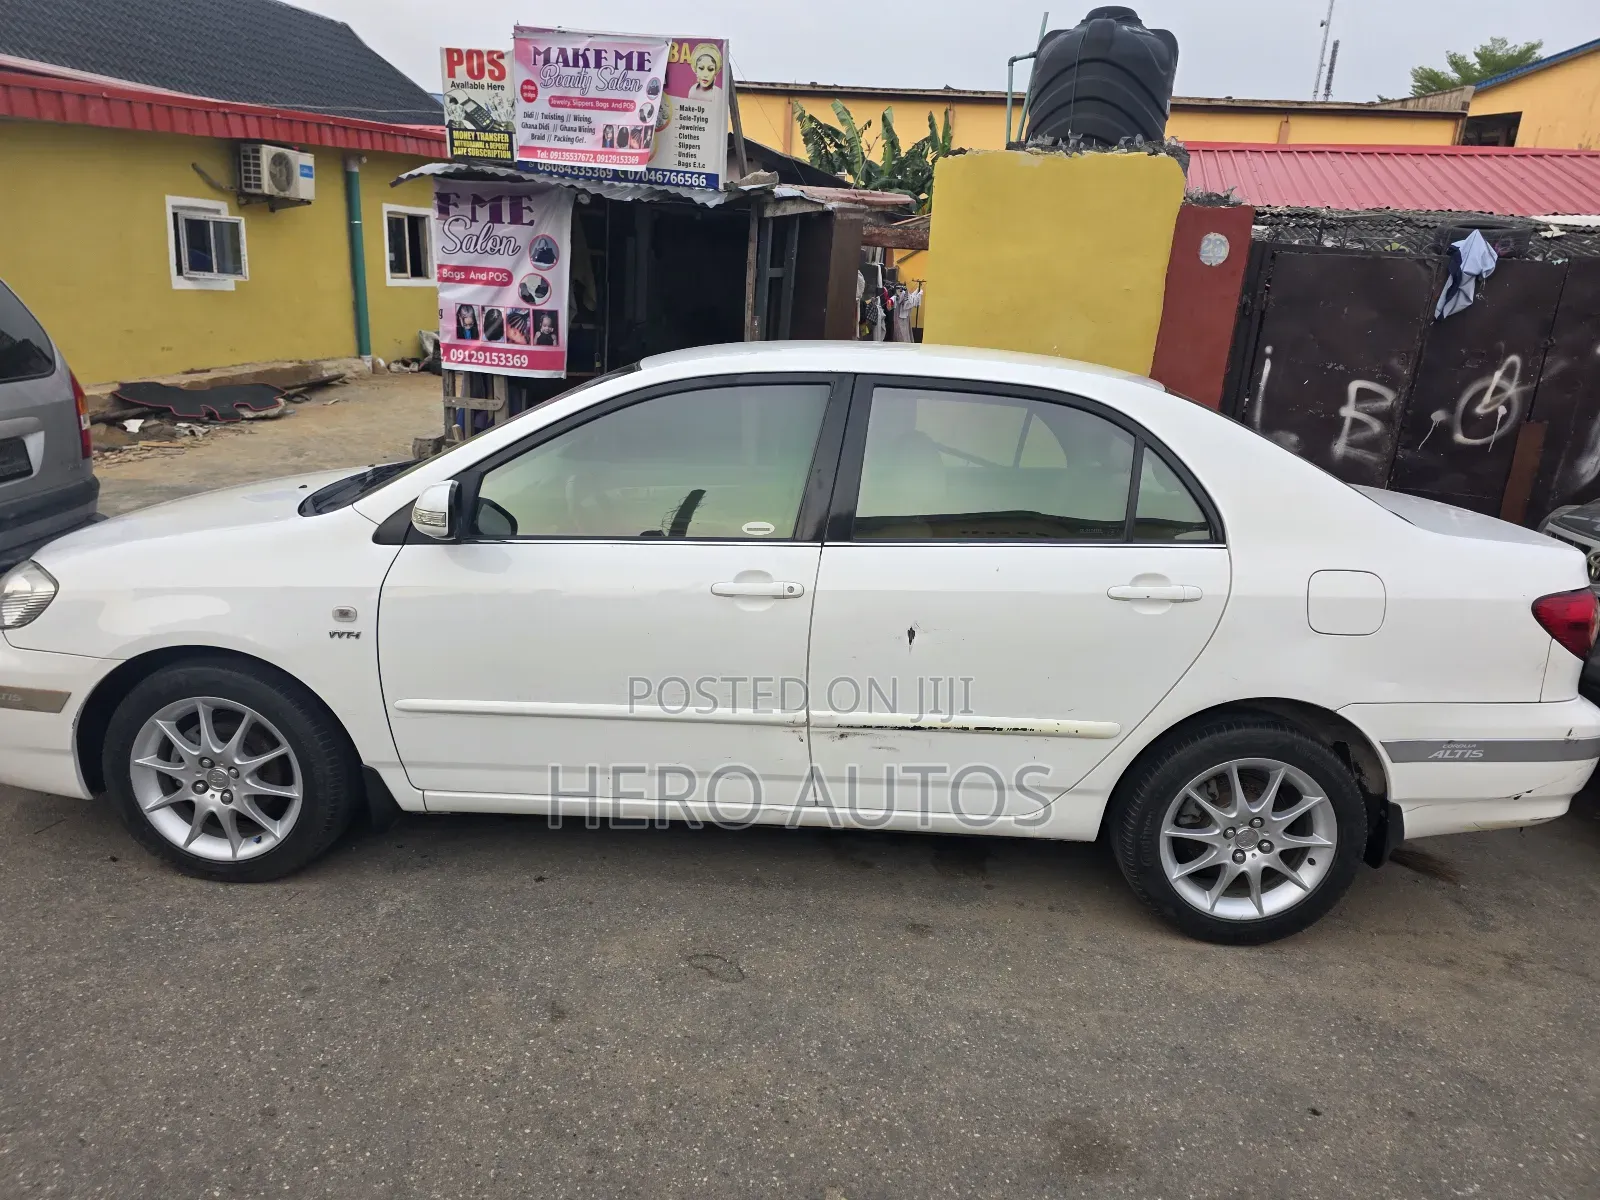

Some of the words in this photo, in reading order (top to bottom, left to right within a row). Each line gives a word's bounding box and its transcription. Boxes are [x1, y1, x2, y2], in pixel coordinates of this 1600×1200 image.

[445, 48, 506, 81] POS
[540, 62, 592, 96] Beauty
[595, 65, 643, 93] Salon
[450, 81, 485, 90] Available
[487, 82, 505, 91] Here
[595, 100, 609, 109] Bags
[611, 100, 622, 109] And
[622, 101, 635, 110] POS
[679, 104, 705, 114] Make-Up
[523, 111, 535, 119] Didi
[540, 112, 565, 122] Twisting
[679, 114, 709, 124] Gele-Tying
[521, 122, 538, 130] Ghana
[538, 122, 550, 131] Didi
[559, 124, 577, 133] Ghana
[452, 130, 475, 140] MONEY
[476, 131, 510, 142] TRANSFER
[530, 133, 546, 141] Braid
[553, 134, 574, 144] Packing
[678, 132, 700, 141] Clothes
[489, 142, 509, 150] DEPOSIT
[678, 142, 701, 151] Slippers
[467, 147, 512, 159] SUBSCRIPTION
[537, 150, 549, 159] Tel:
[596, 154, 639, 165] 09129153369
[677, 151, 697, 159] Undies
[677, 160, 692, 169] Bags
[627, 170, 707, 187] 07046766566
[470, 193, 535, 226] ME
[441, 215, 521, 256] Salon
[442, 268, 465, 280] Bags
[469, 270, 487, 281] And
[488, 271, 508, 282] POS
[450, 348, 528, 367] 09129153369
[1427, 749, 1485, 759] ALTIS
